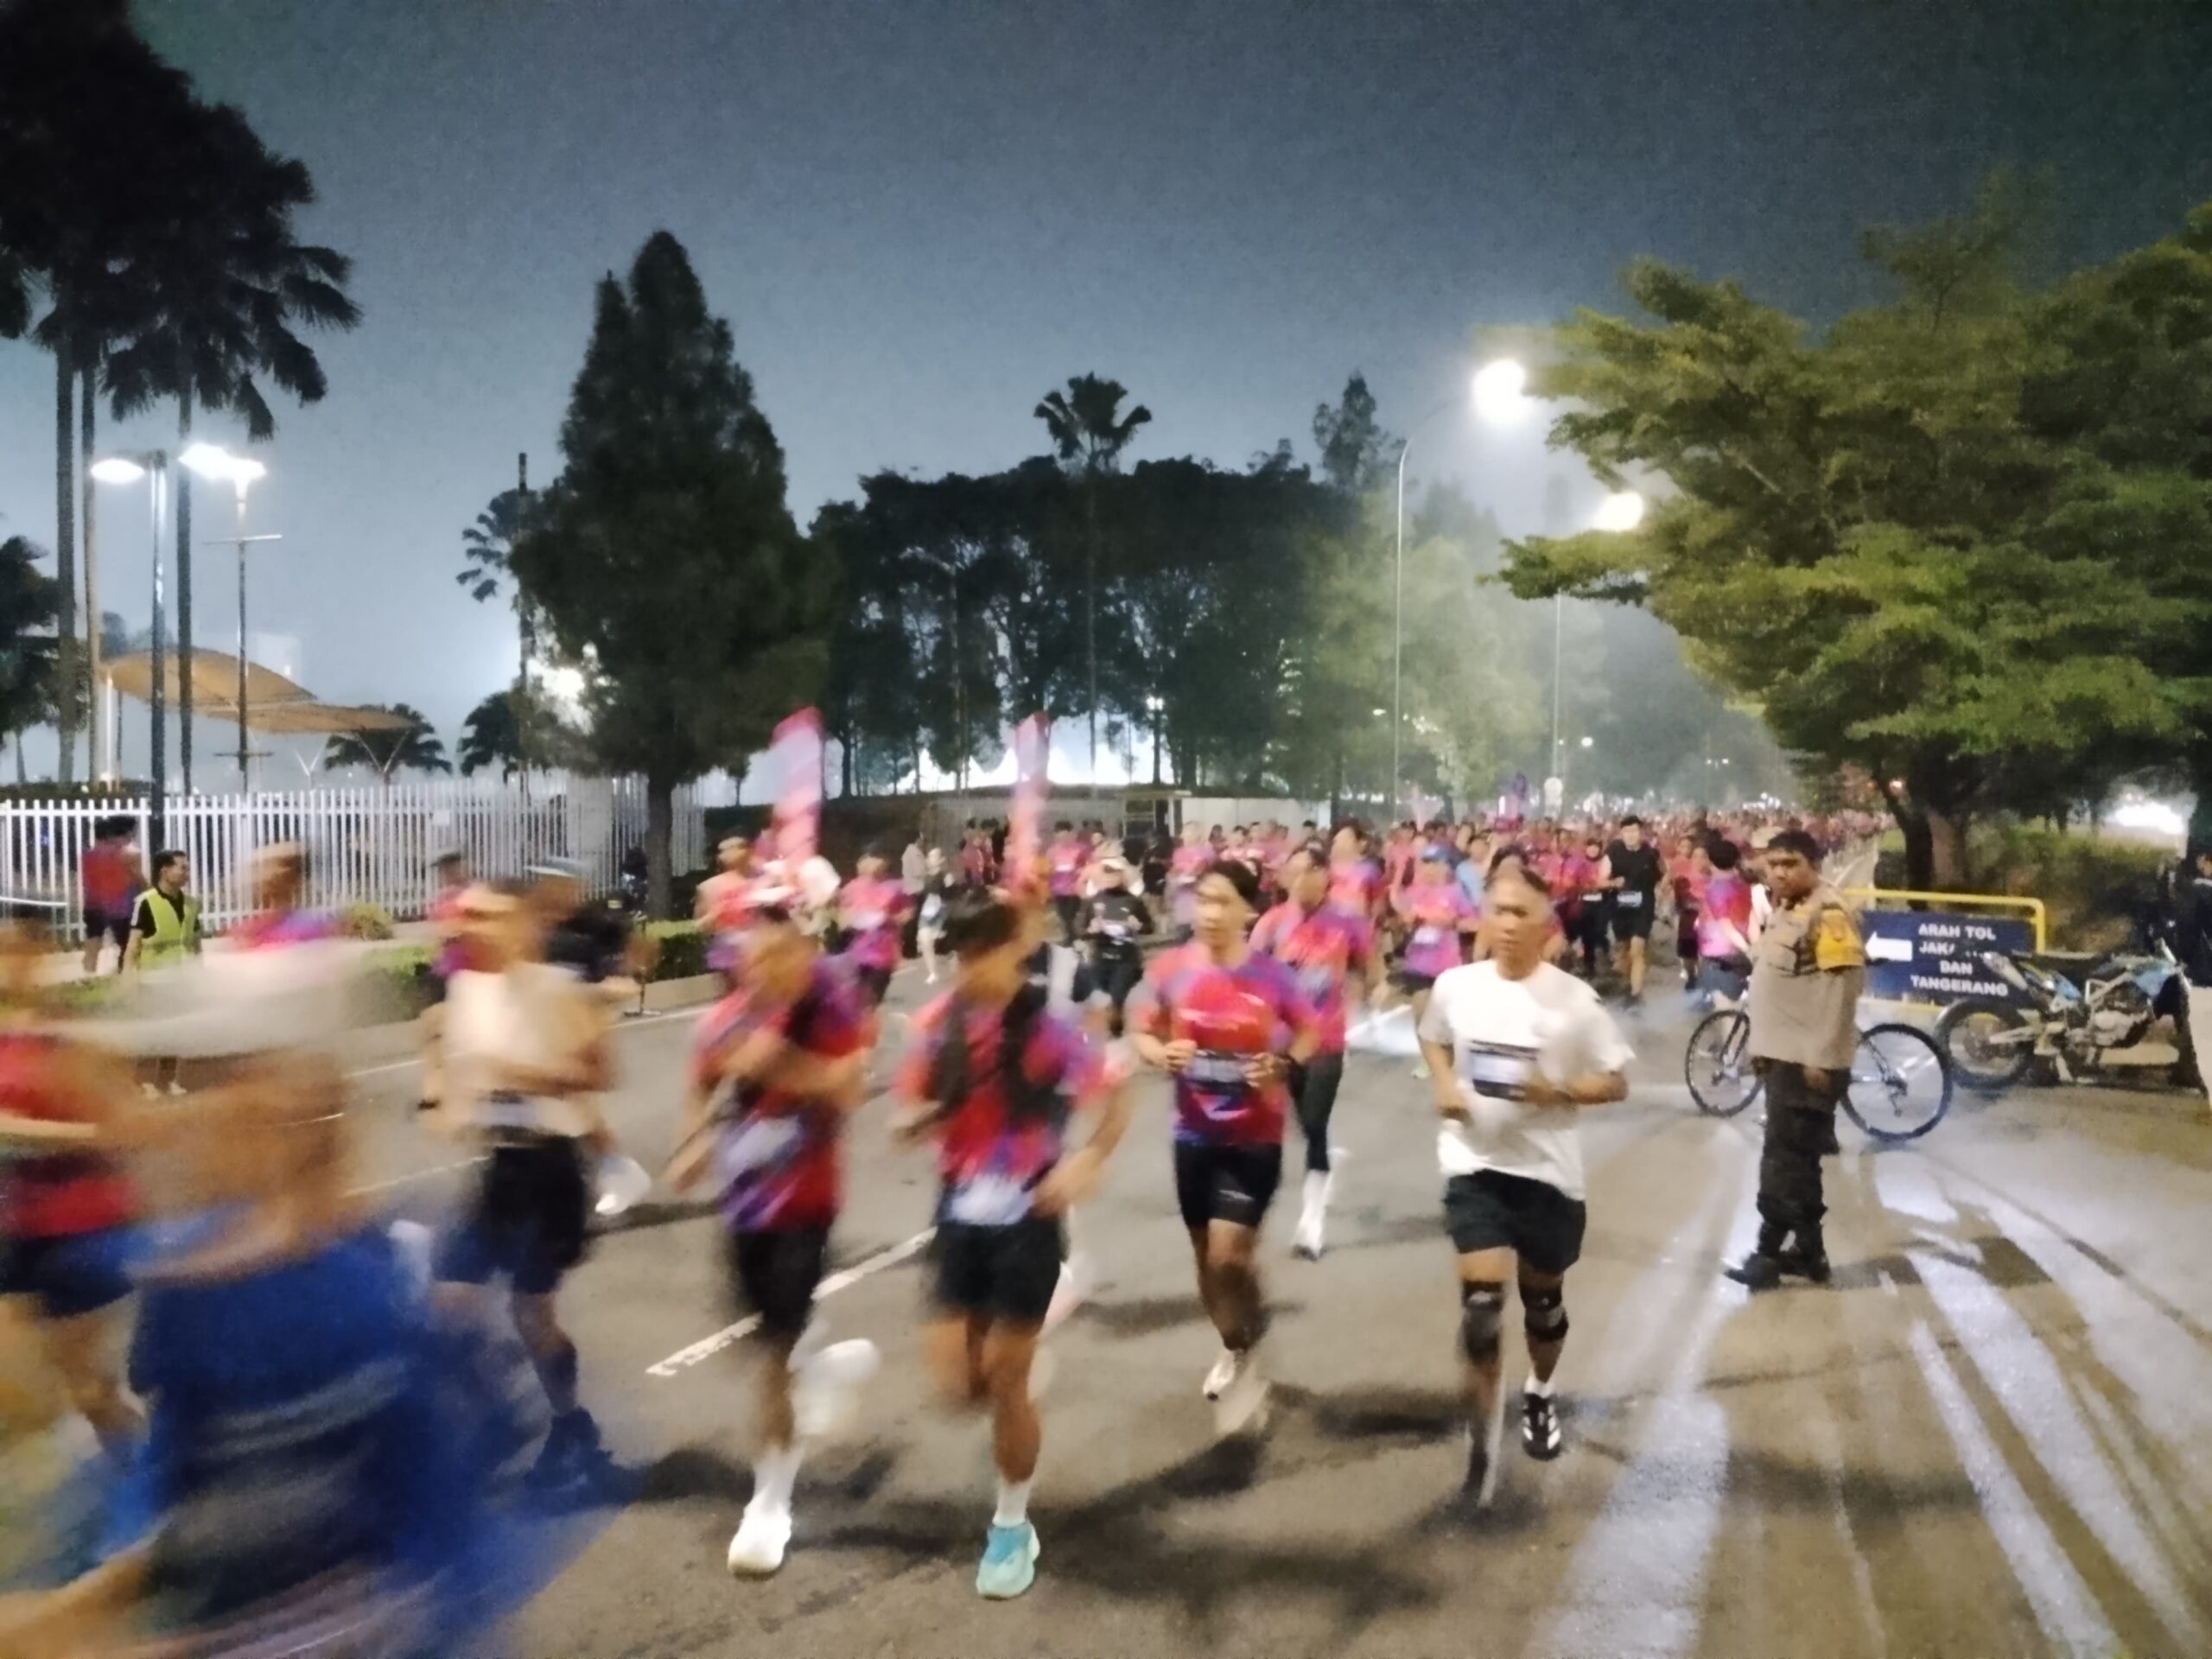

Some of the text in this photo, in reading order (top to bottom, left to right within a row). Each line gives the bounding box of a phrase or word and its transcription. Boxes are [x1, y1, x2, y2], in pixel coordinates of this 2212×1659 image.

[1919, 924, 1996, 940] ARAH TOL
[1940, 960, 1973, 975] DAN
[1910, 975, 2008, 996] TANGERANG
